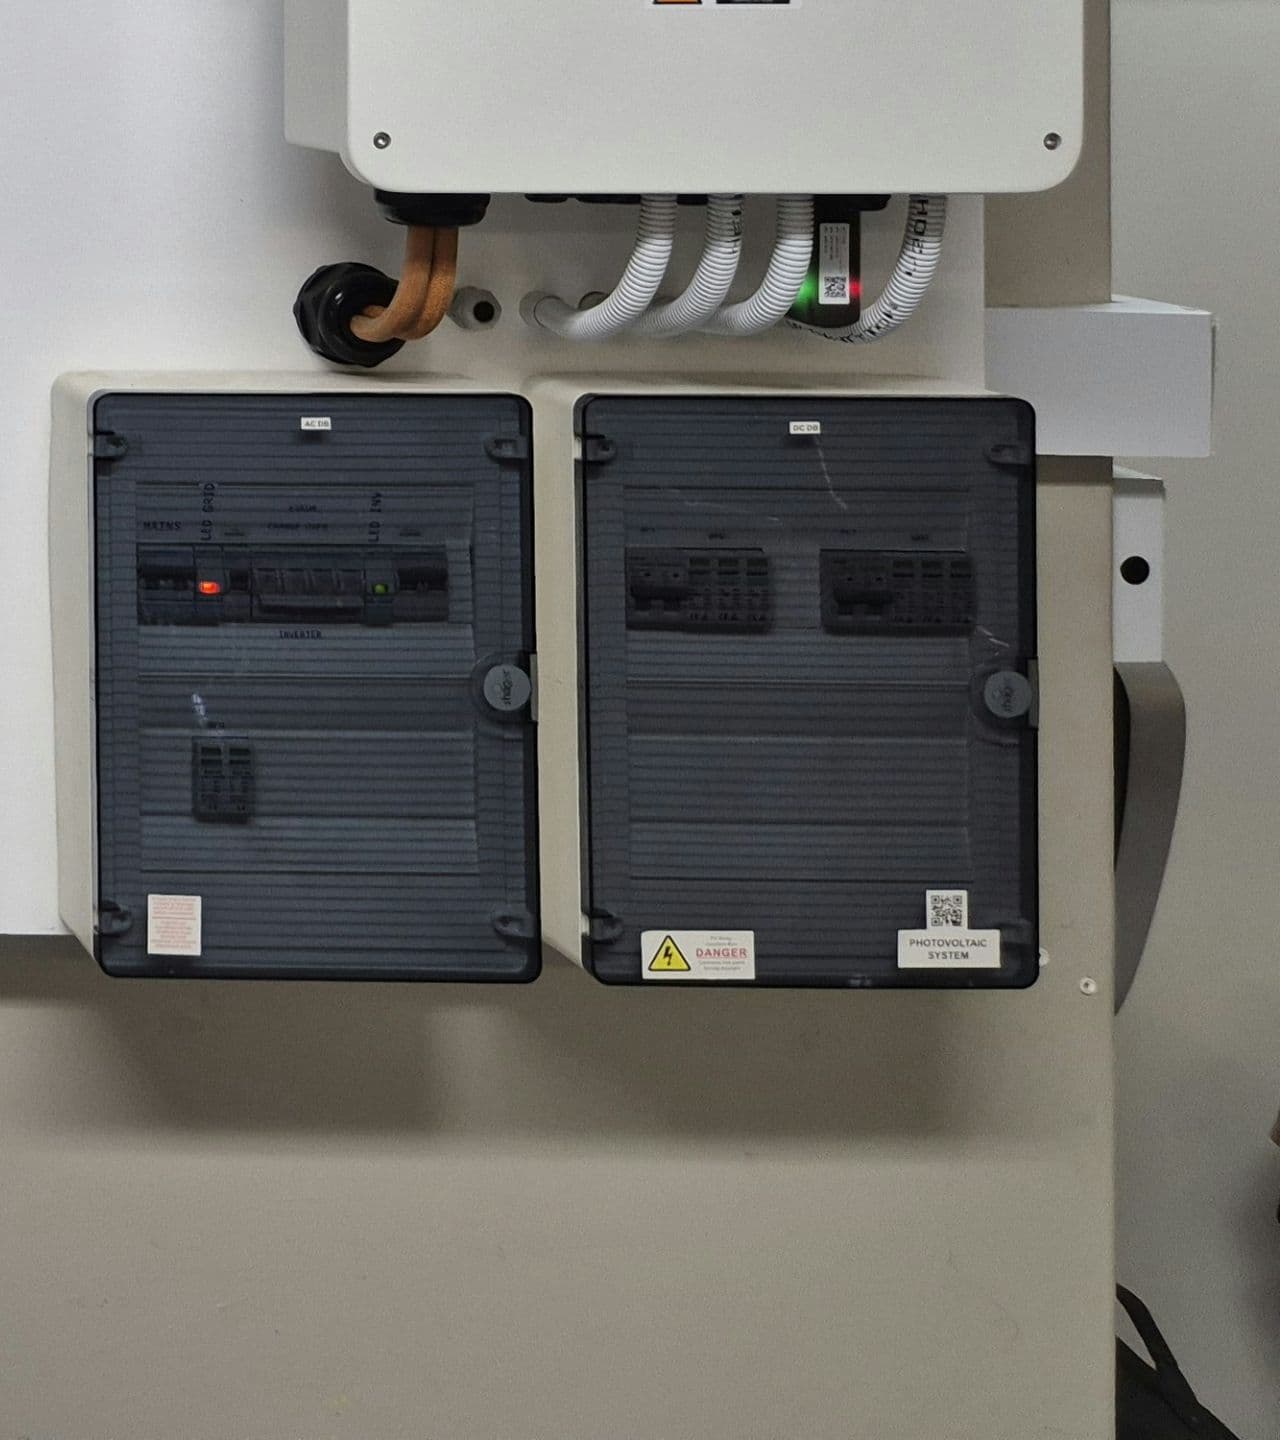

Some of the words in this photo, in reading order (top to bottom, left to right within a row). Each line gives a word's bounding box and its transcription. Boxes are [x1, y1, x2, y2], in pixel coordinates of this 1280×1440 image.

[909, 938, 988, 948] PHOTOVOLTAIC
[695, 947, 748, 958] DANGER
[927, 951, 969, 960] SYSTEM
